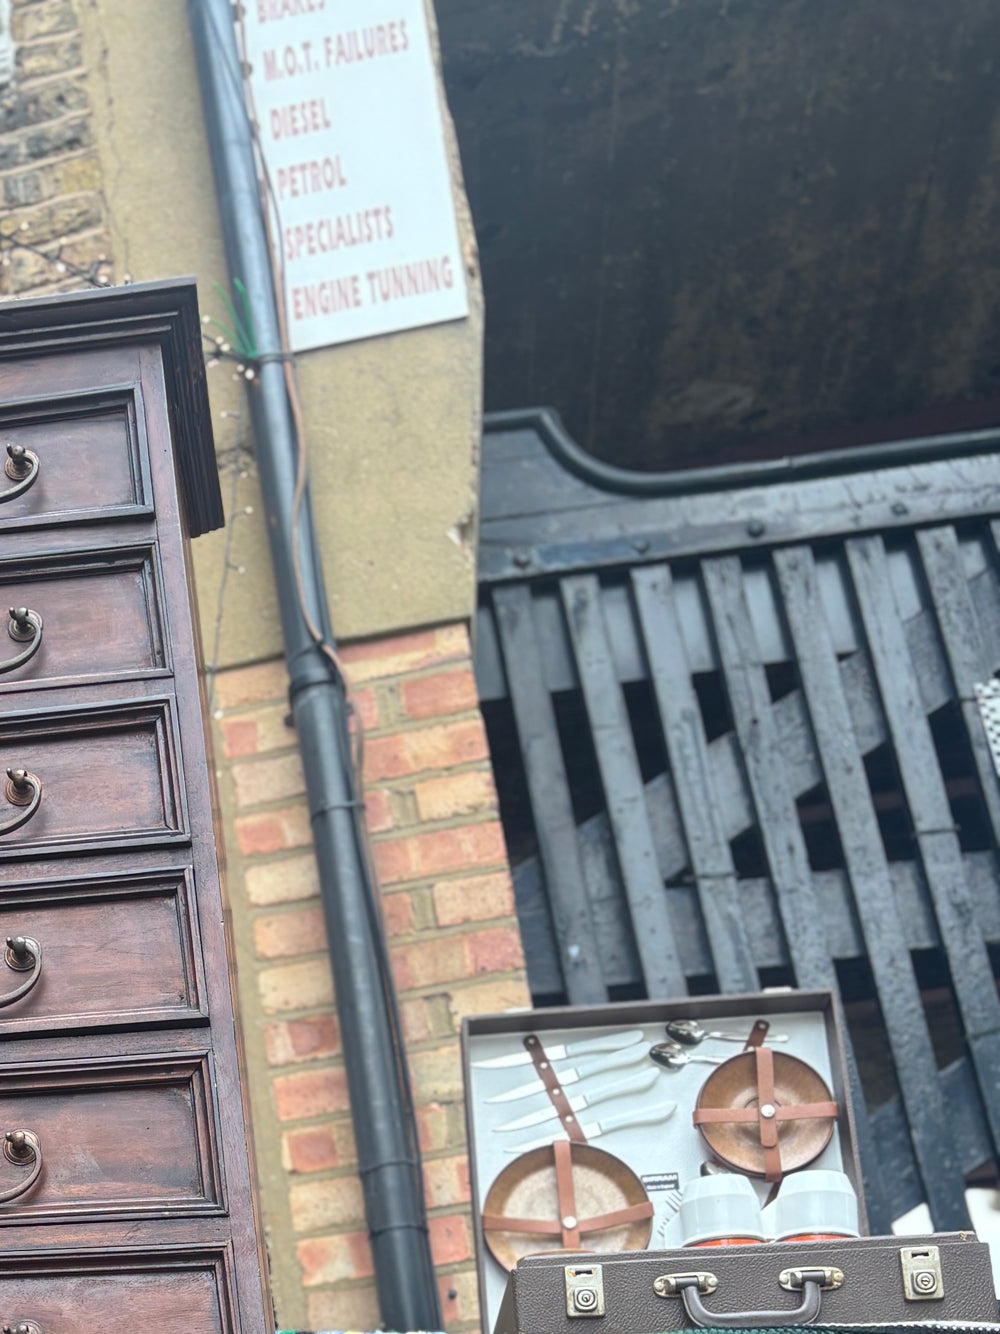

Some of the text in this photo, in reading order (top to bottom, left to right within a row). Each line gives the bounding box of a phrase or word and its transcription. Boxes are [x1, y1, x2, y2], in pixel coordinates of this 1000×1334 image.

[256, 0, 326, 23] BRAK
[263, 19, 409, 81] M.O.T. FAILURES
[269, 98, 332, 140] DIESEL
[276, 155, 347, 200] PETROL
[284, 205, 395, 260] SPECIALISTS
[291, 255, 454, 321] ENGINE TUNNING
